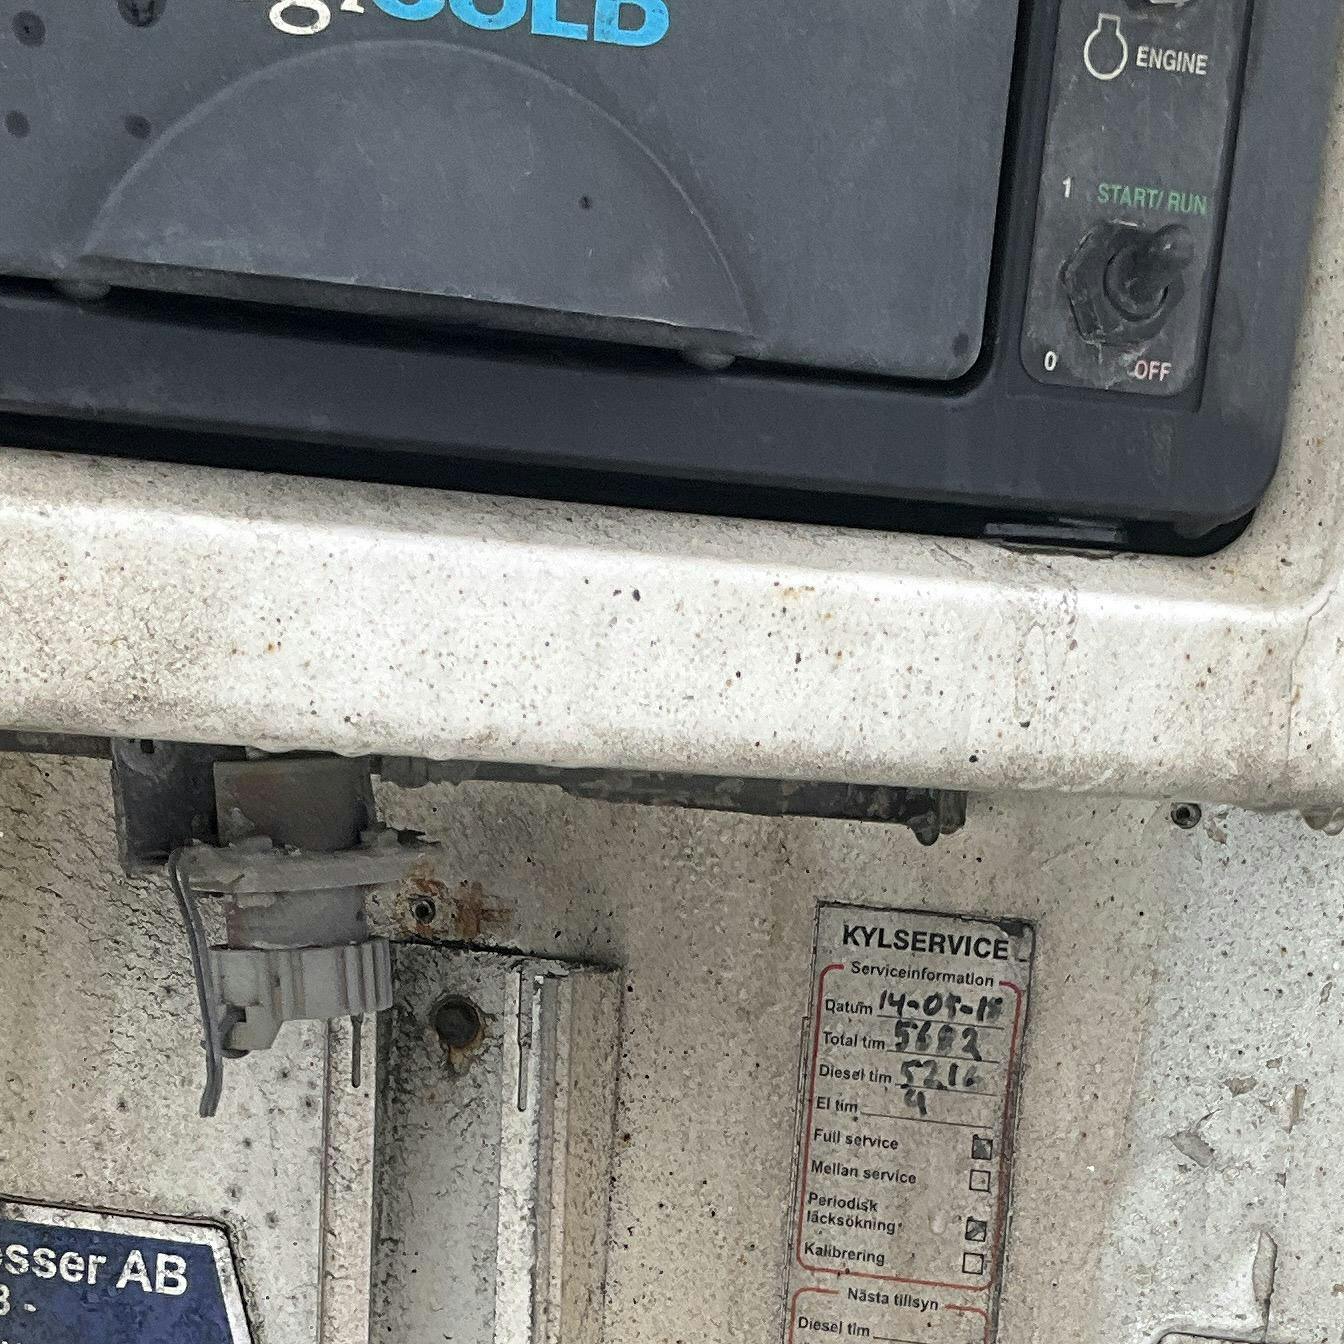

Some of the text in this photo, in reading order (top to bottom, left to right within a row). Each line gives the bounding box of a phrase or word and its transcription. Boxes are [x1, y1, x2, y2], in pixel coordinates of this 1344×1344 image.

[1136, 46, 1208, 76] ENGINE
[1062, 176, 1073, 199] 1
[1168, 192, 1207, 216] RUN
[1043, 350, 1172, 382] 0 OFF
[842, 925, 1009, 960] KYLSERVICE
[850, 960, 994, 988] Serviceinformation
[825, 999, 873, 1016] Datum
[822, 1031, 886, 1050] Total tim
[818, 1063, 892, 1084] Diesel tim
[816, 1096, 858, 1113] El tim
[813, 1128, 899, 1150] Full service
[811, 1159, 917, 1184] Mellan service
[807, 1191, 879, 1212] Periodisk
[804, 1242, 885, 1267] Kalibrering
[115, 1249, 189, 1297] AB
[847, 1287, 939, 1312] Nästa tillsyn
[798, 1316, 870, 1337] Diesel tim
